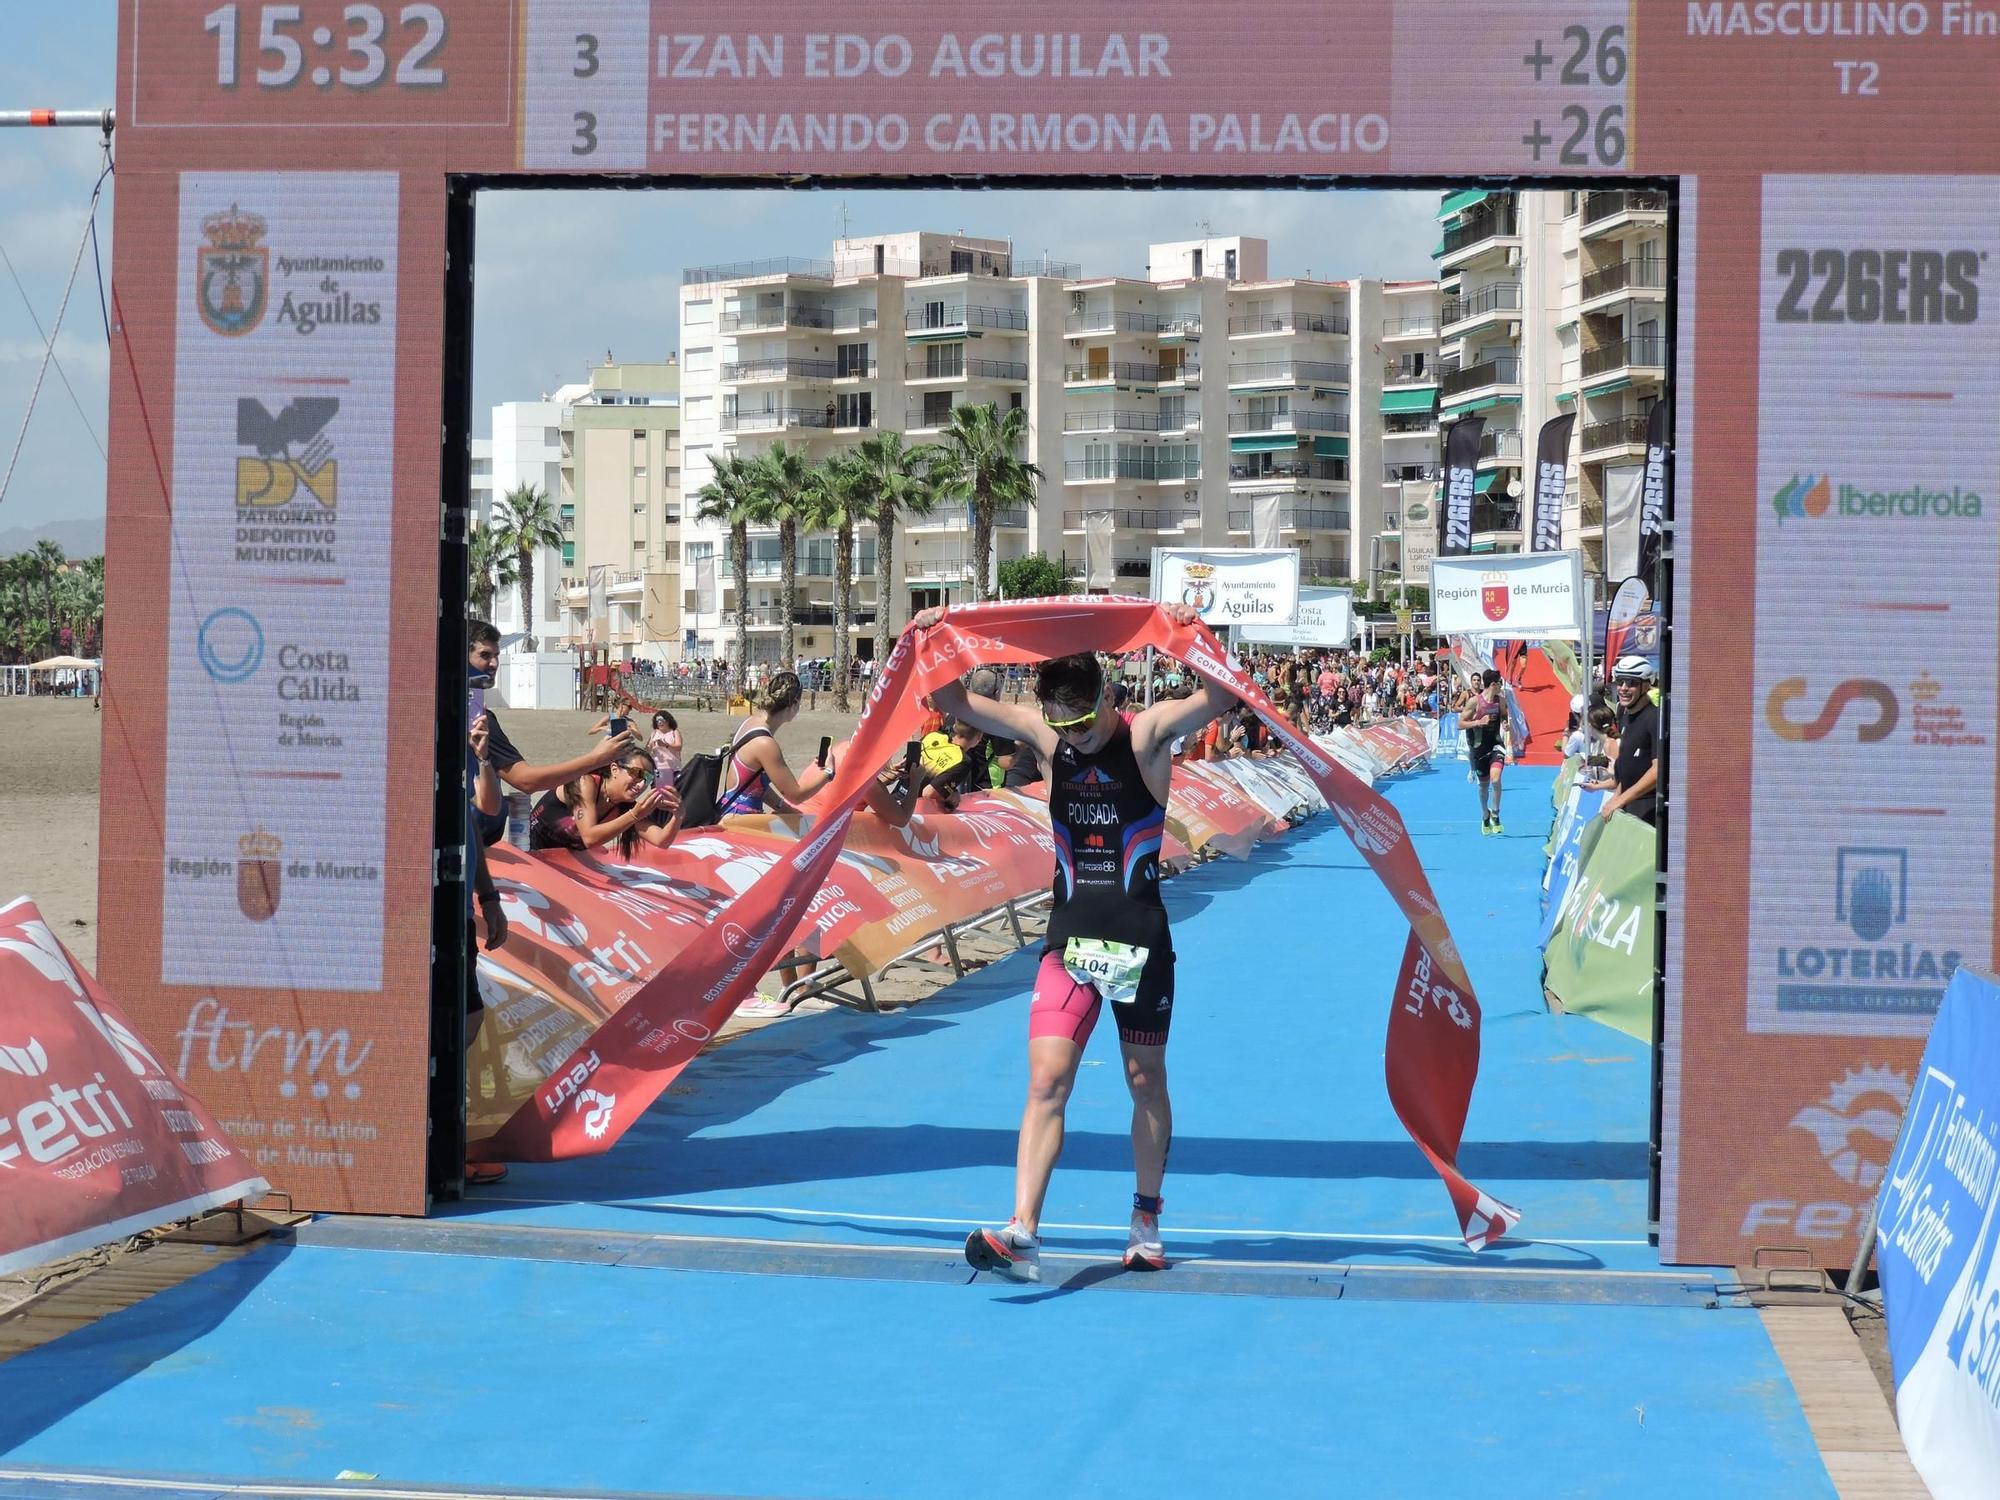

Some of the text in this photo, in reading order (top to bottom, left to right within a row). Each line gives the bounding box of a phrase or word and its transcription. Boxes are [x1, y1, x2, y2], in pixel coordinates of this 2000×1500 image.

[1686, 1, 1929, 36] MASCULINO
[203, 2, 447, 88] 15:32
[573, 25, 1627, 87] 3 IZAN EDO AGUILAR +26
[1834, 61, 1880, 96] T2
[571, 104, 1626, 167] 3 FERNANDO CARMONA PALACIO +26
[275, 256, 384, 276] Ayuntamiento
[319, 275, 339, 294] de
[1776, 248, 1980, 325] 226ERS
[275, 292, 381, 335] Águilas
[1446, 466, 1474, 549] 226ERS
[1535, 462, 1565, 551] 226ERS
[1837, 483, 1983, 518] Iberdrola
[235, 509, 337, 526] PATRONATO
[235, 527, 337, 545] DEPORTIVO
[235, 547, 336, 563] MUNICIPAL
[1221, 581, 1276, 593] Ayuntamiento
[1244, 592, 1254, 600] de
[1437, 582, 1570, 600] Región de Murcia
[1221, 598, 1274, 618] Águilas
[1298, 604, 1321, 614] osta
[278, 644, 350, 672] Costa
[1196, 656, 1217, 671] CON
[277, 675, 361, 702] Cálida
[278, 713, 325, 729] Región
[278, 731, 343, 747] de Murcia
[1068, 803, 1120, 825] POUSADA
[1361, 812, 1401, 844] DEPORTIVO
[168, 856, 378, 880] Región de Murcia
[1068, 956, 1110, 976] 4104
[1777, 943, 1962, 981] LOTERÍAS
[176, 997, 374, 1082] ftrm
[545, 1049, 601, 1114] Fetri
[272, 1119, 296, 1137] de
[287, 1146, 354, 1167] Murcia
[1896, 1183, 1953, 1286] Sanitas
